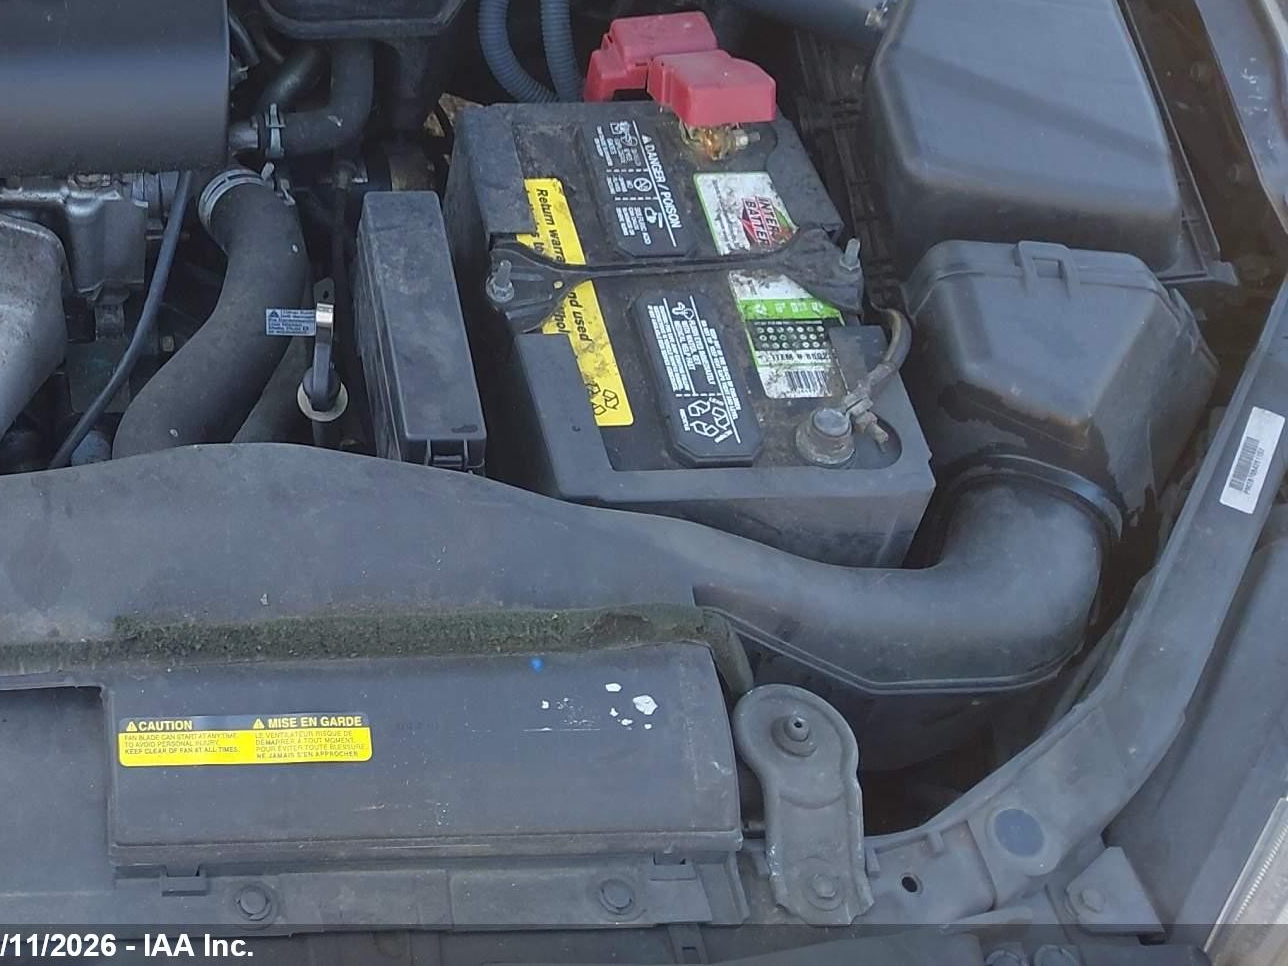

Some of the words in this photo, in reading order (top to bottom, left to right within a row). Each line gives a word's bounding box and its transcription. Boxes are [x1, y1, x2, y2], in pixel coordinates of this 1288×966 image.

[645, 144, 666, 182] DANGER
[660, 192, 682, 228] POISON
[536, 188, 554, 226] Return
[567, 290, 583, 310] nd
[573, 311, 592, 343] used
[138, 720, 192, 731] CAUTION
[268, 717, 297, 729] MISE
[301, 717, 317, 727] EN
[320, 716, 362, 727] GARDE
